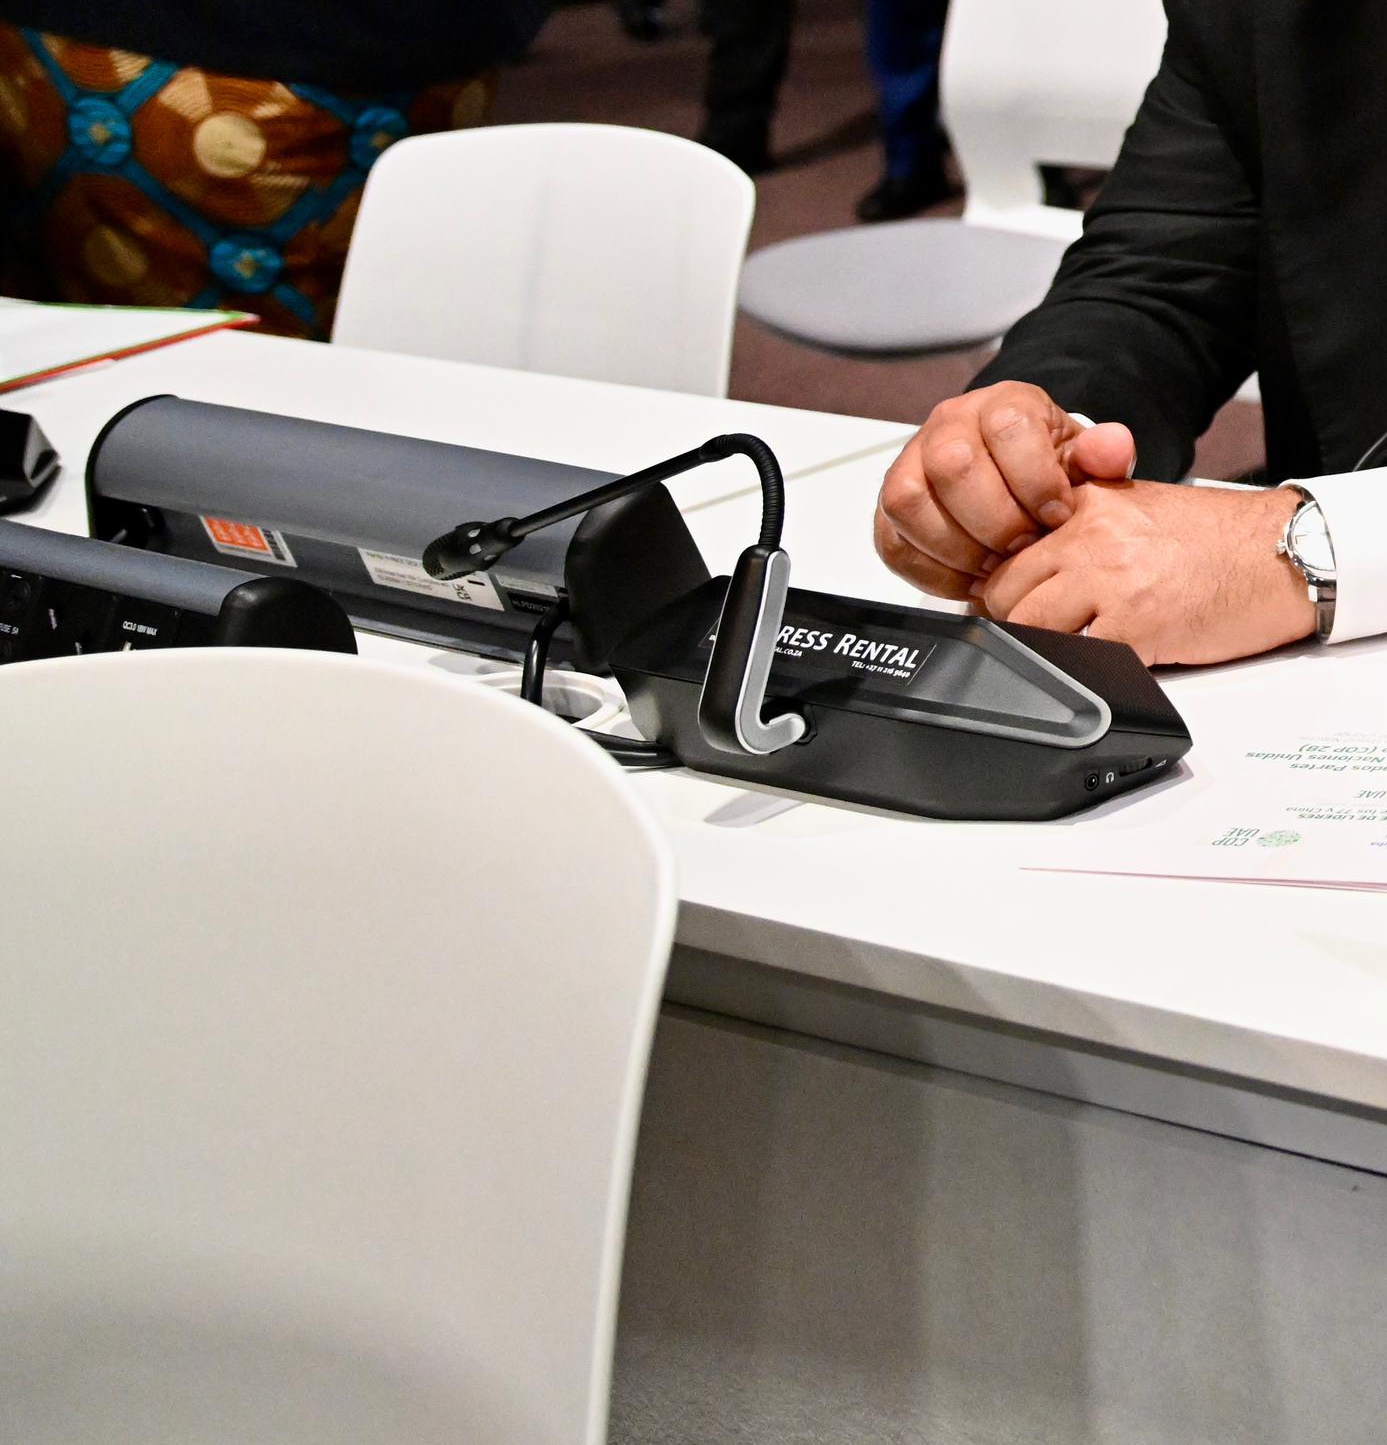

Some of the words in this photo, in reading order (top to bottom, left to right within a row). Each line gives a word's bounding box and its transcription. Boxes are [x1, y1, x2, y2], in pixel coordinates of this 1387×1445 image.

[775, 646, 803, 657] AL.CO.ZA
[777, 625, 833, 651] RESS
[833, 633, 920, 668] RENTAL
[851, 660, 866, 669] TEL:
[1245, 751, 1302, 761] Unidas
[1307, 753, 1386, 763] Naciones
[1290, 763, 1348, 772] Partes
[1353, 789, 1387, 799] UAE
[1222, 827, 1261, 838] UAE
[1211, 837, 1250, 847] COP
